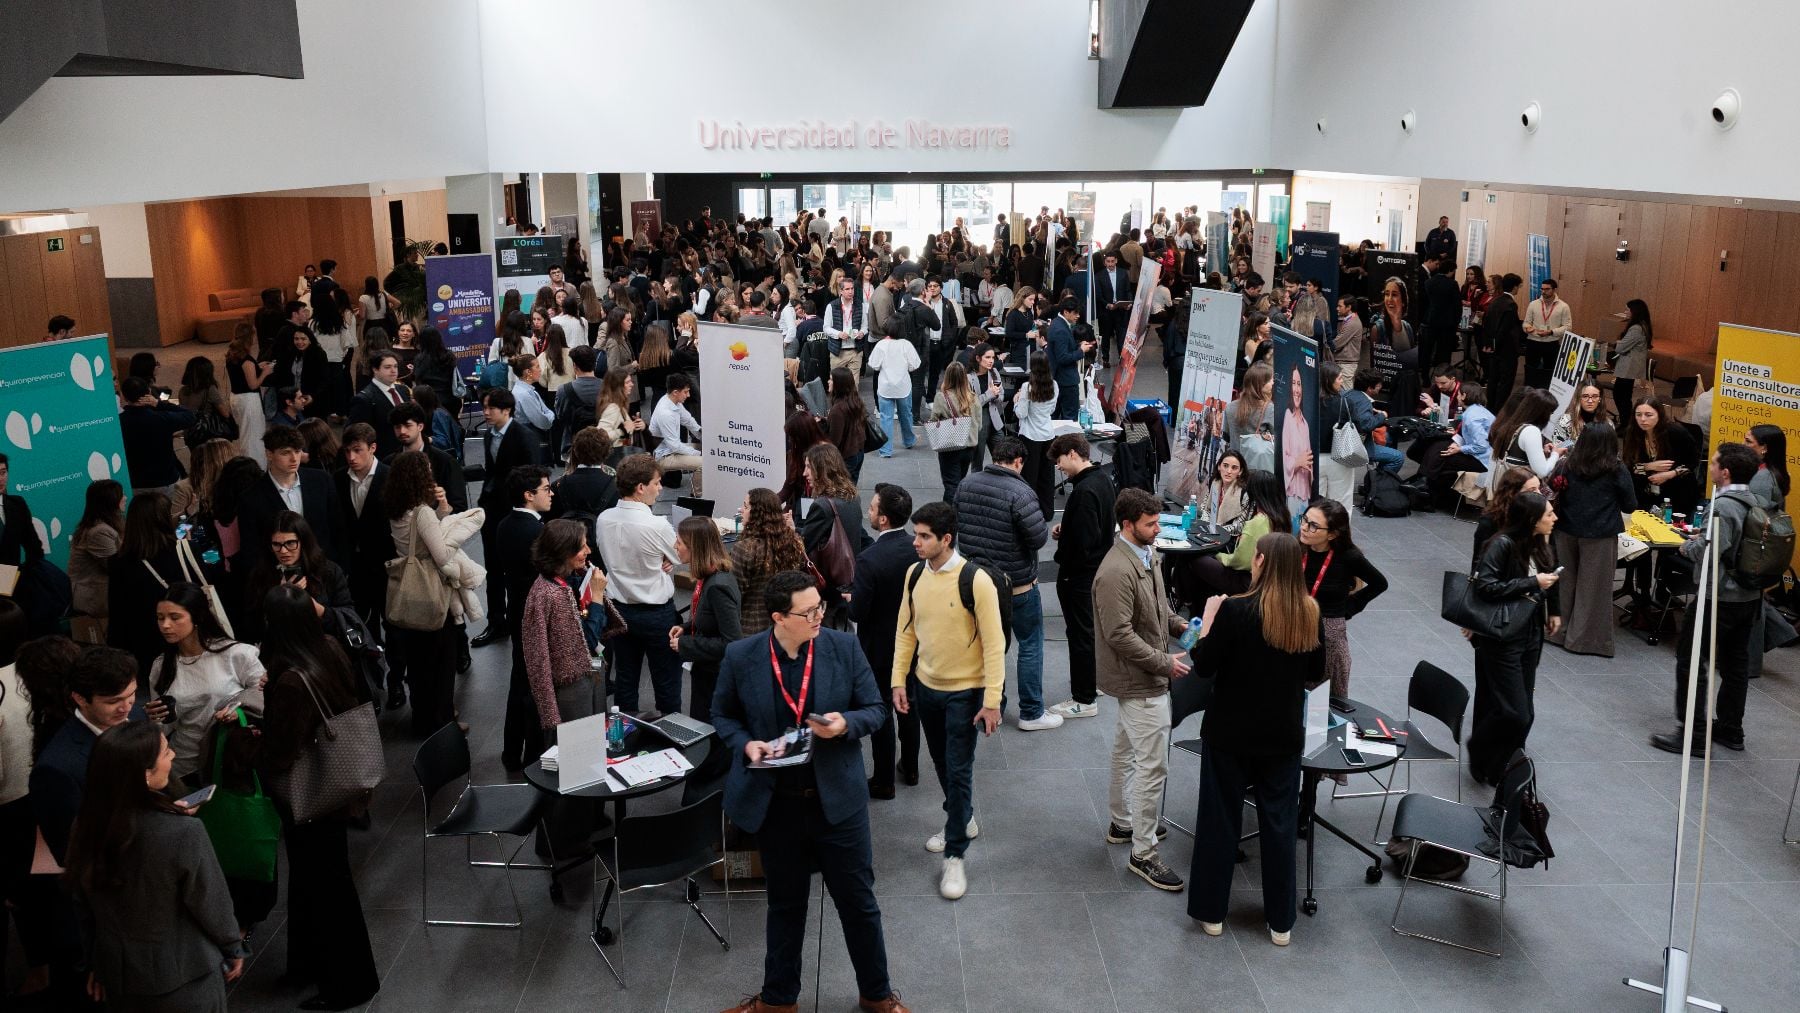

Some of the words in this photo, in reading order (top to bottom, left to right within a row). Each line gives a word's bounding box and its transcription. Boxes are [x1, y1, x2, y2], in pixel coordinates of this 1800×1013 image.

[698, 119, 856, 149] Universidad
[866, 119, 897, 148] de
[904, 119, 1011, 149] Navarra
[455, 237, 462, 246] B
[448, 296, 492, 309] UNIVERSITY
[448, 305, 493, 315] AMBASSADORS
[1553, 333, 1591, 388] HOLA
[1723, 359, 1760, 376] Únete
[1763, 369, 1771, 378] a
[1722, 372, 1733, 384] la
[1736, 377, 1800, 397] consultora
[1721, 386, 1800, 410] internaciona
[1720, 401, 1743, 413] que
[1746, 406, 1772, 418] está
[728, 420, 753, 433] Suma
[718, 434, 729, 443] tu
[731, 437, 763, 449] talento
[717, 447, 727, 458] la
[728, 451, 771, 466] transición
[717, 464, 765, 479] energética
